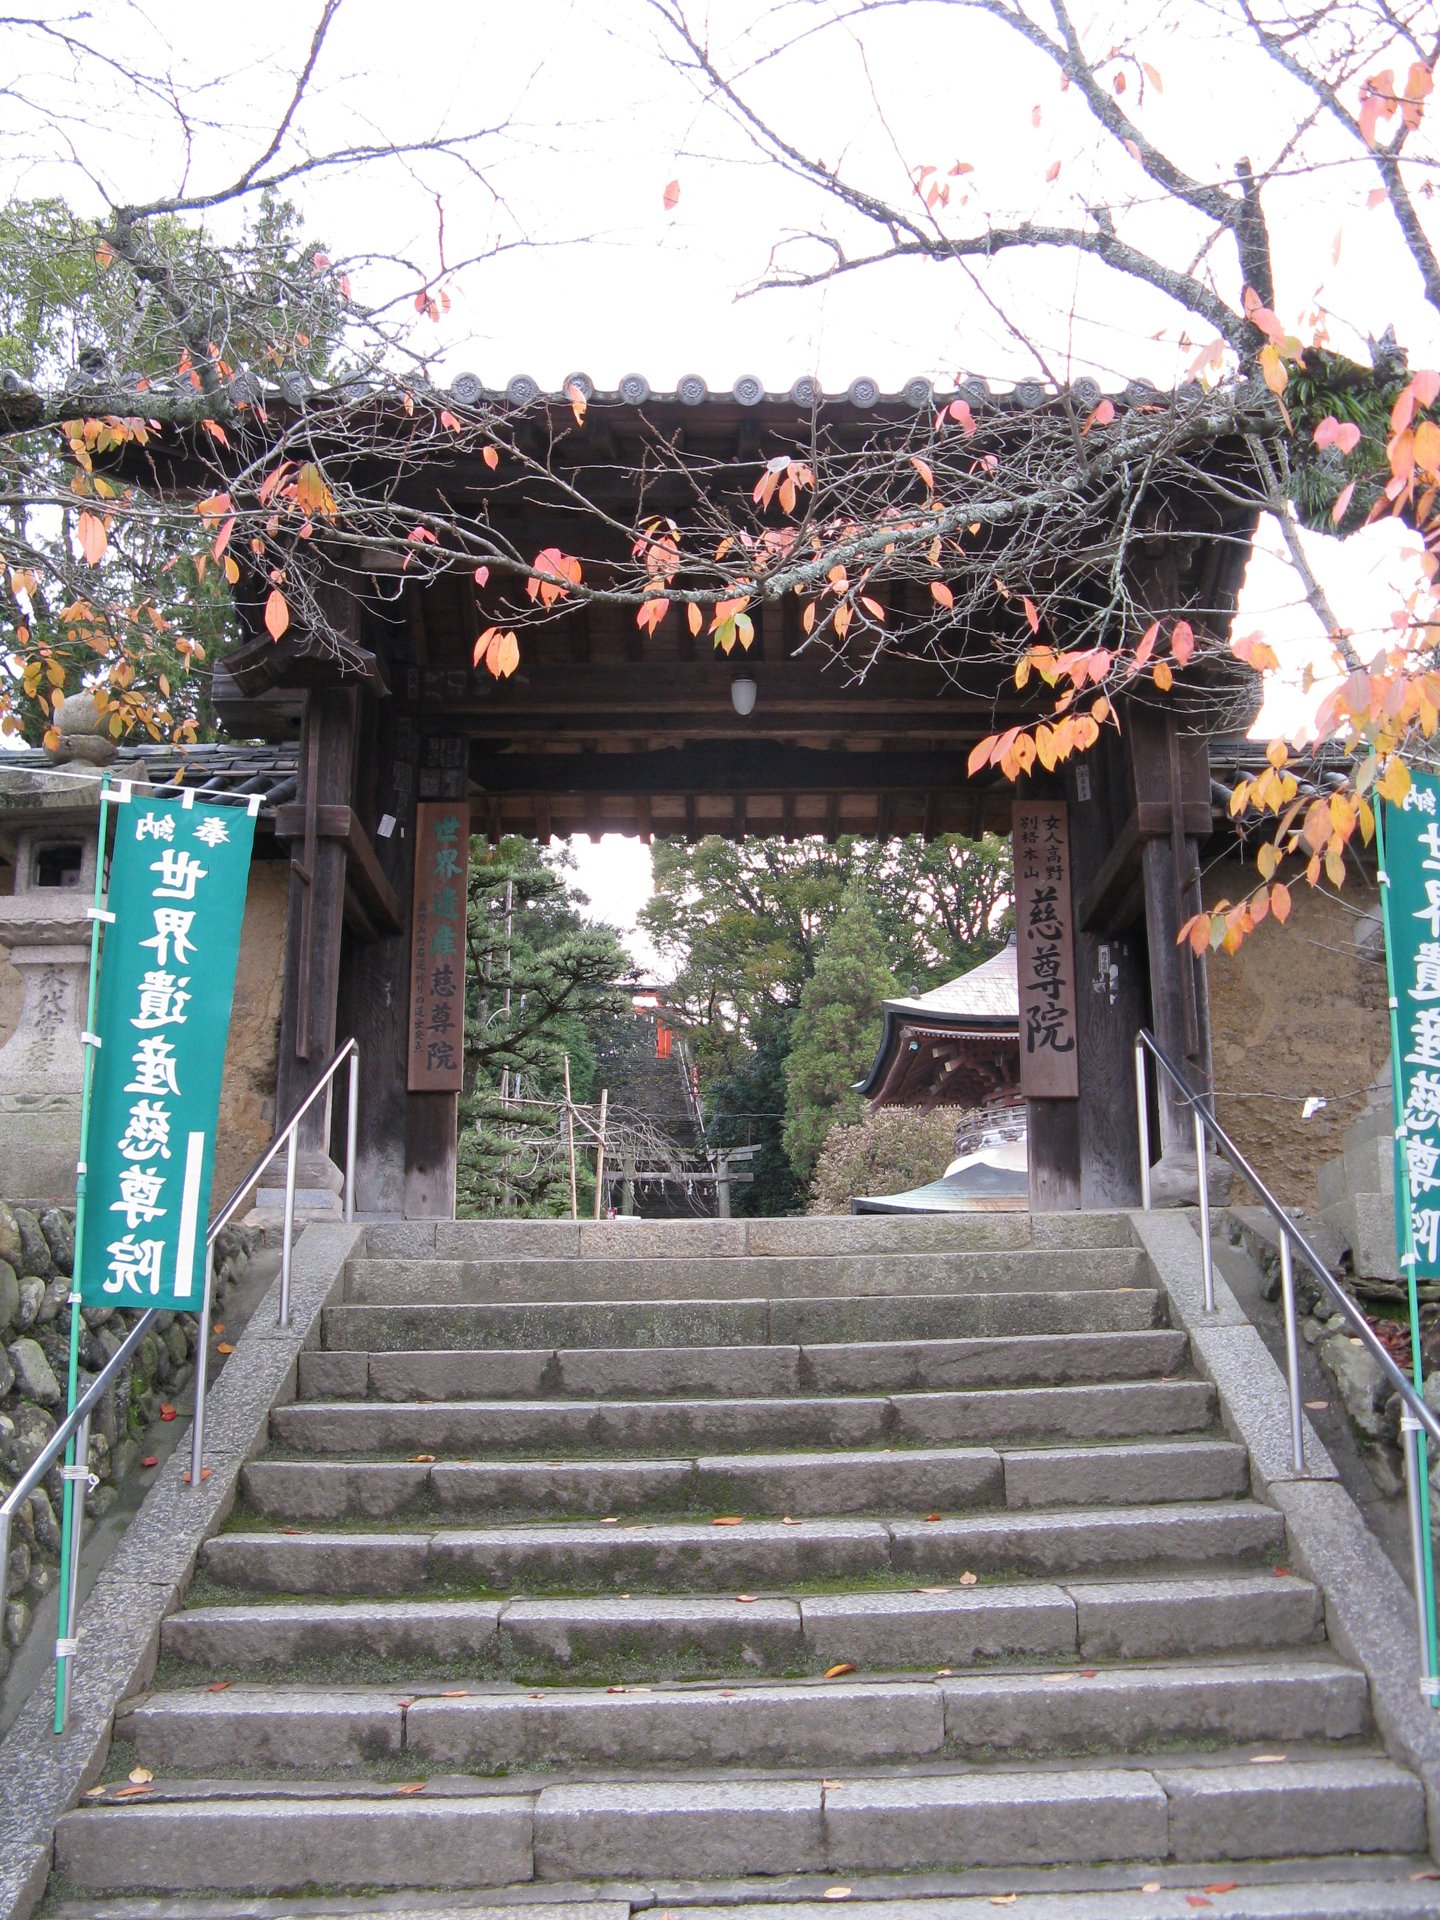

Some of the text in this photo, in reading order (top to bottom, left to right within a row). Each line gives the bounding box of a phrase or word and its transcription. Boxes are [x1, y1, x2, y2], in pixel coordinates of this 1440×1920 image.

[1020, 815, 1040, 880] 別格本山
[1044, 814, 1065, 882] 女人高野
[426, 815, 463, 1072] 世界遺産慈尊院
[1025, 886, 1075, 1053] 慈尊院
